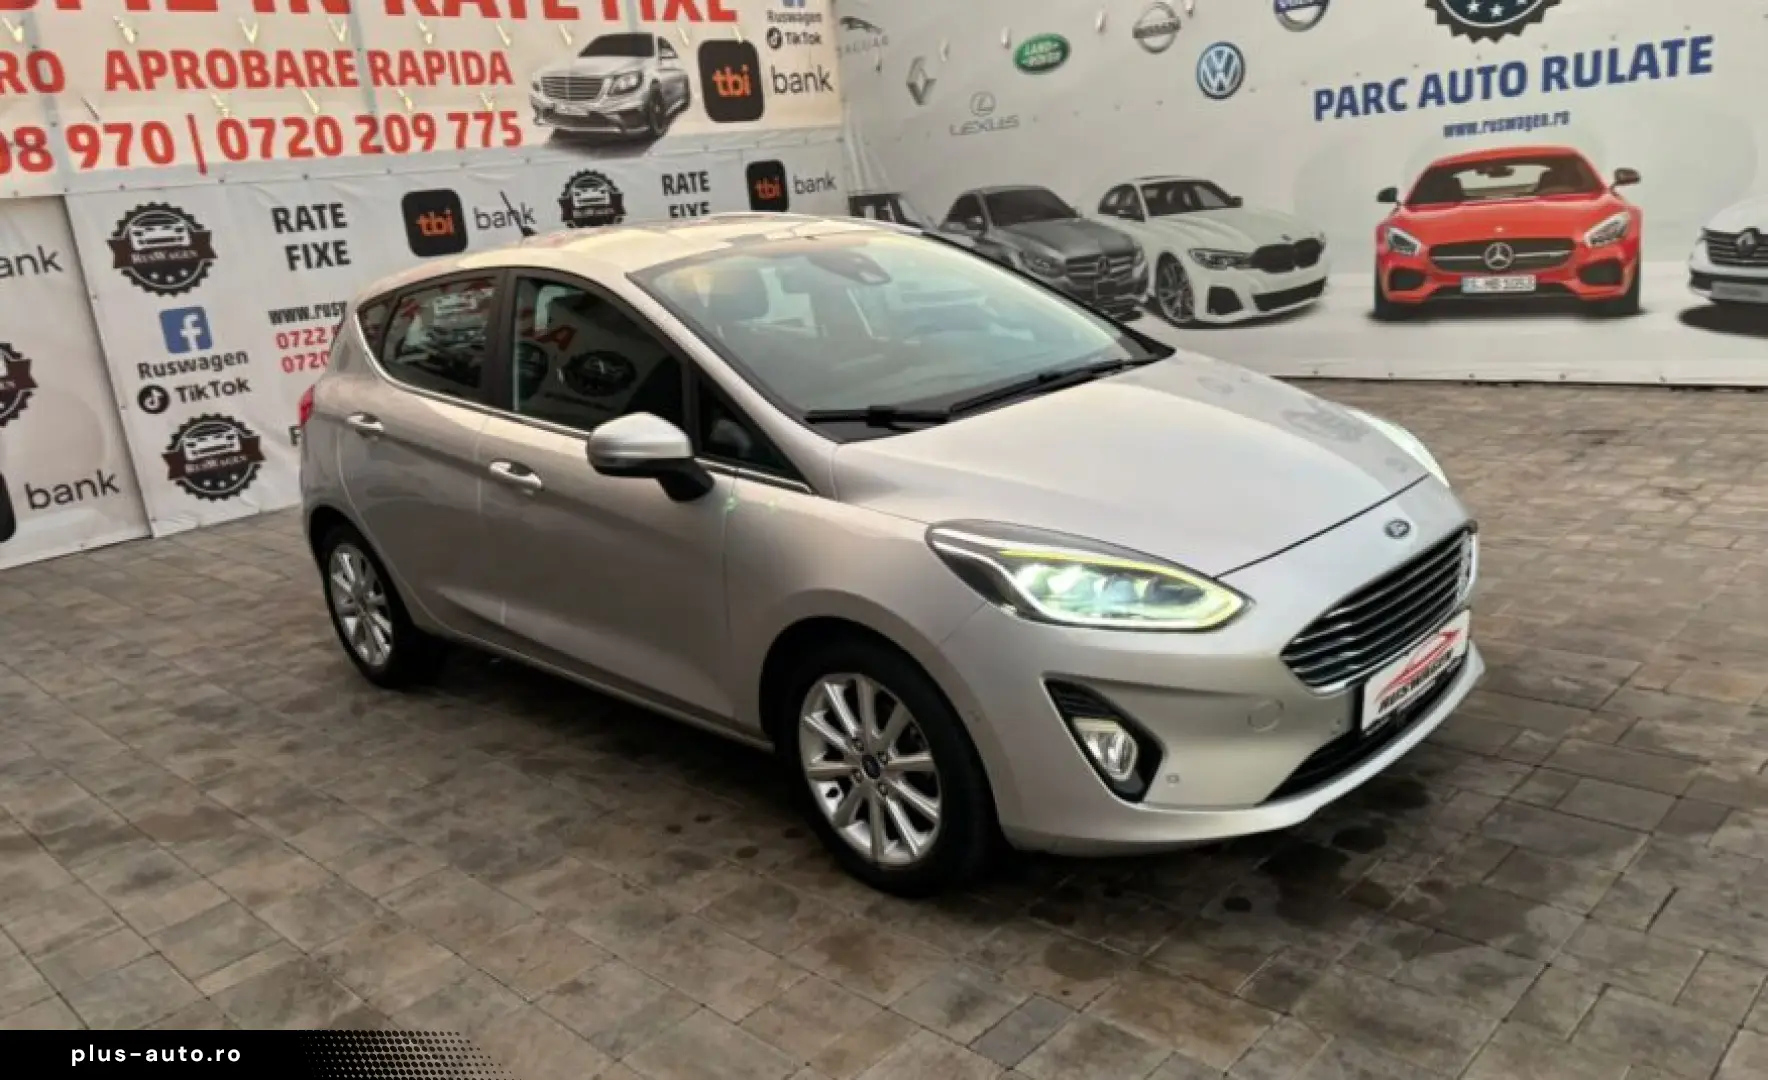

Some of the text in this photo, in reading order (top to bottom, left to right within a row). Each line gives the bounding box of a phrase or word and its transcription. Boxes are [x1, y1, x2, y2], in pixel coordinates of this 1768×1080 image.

[105, 48, 360, 92] APROBARE
[367, 50, 514, 86] RAPIDA
[711, 63, 834, 97] tbi bank
[1313, 35, 1715, 122] PARC AUTO RULATE
[65, 120, 176, 169] 970
[217, 114, 343, 161] 0720
[353, 113, 437, 155] 209
[447, 110, 523, 150] 775
[1443, 110, 1570, 138] www.ruswagen.ro
[661, 171, 711, 196] RATE
[793, 173, 837, 195] bank
[271, 202, 349, 234] RATE
[416, 201, 537, 236] tbi bank
[284, 240, 352, 271] FIXE
[275, 325, 328, 350] 0722
[137, 350, 249, 380] Ruswagen
[176, 378, 251, 404] TikTok
[25, 470, 120, 509] bank
